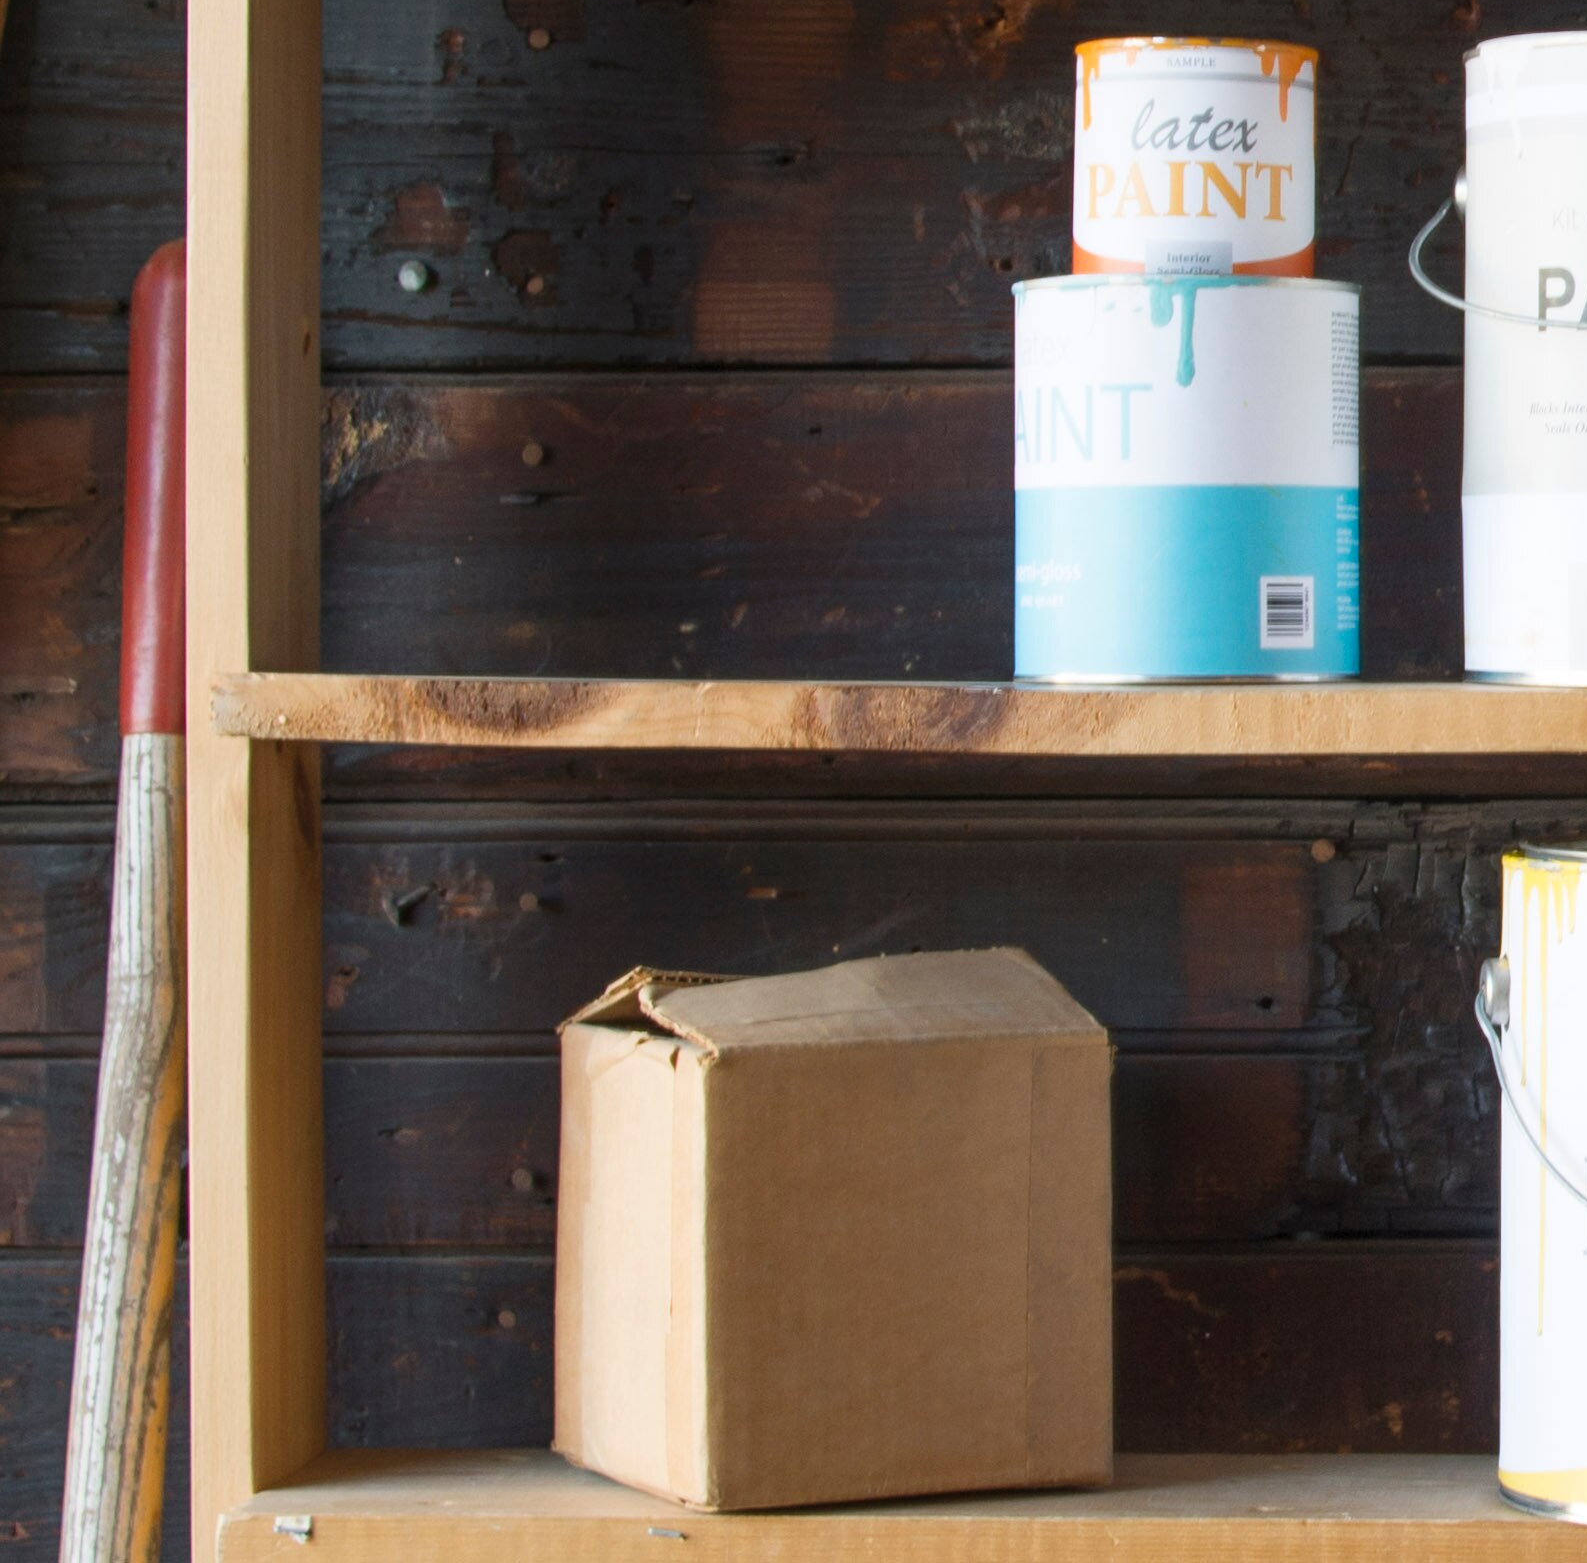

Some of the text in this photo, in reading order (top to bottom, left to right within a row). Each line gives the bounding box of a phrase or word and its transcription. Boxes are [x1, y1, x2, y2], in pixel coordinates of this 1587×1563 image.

[1167, 56, 1217, 68] SAMPLE
[1131, 99, 1258, 153] latex
[1087, 160, 1294, 223] PAINT
[1167, 251, 1211, 264] Interior
